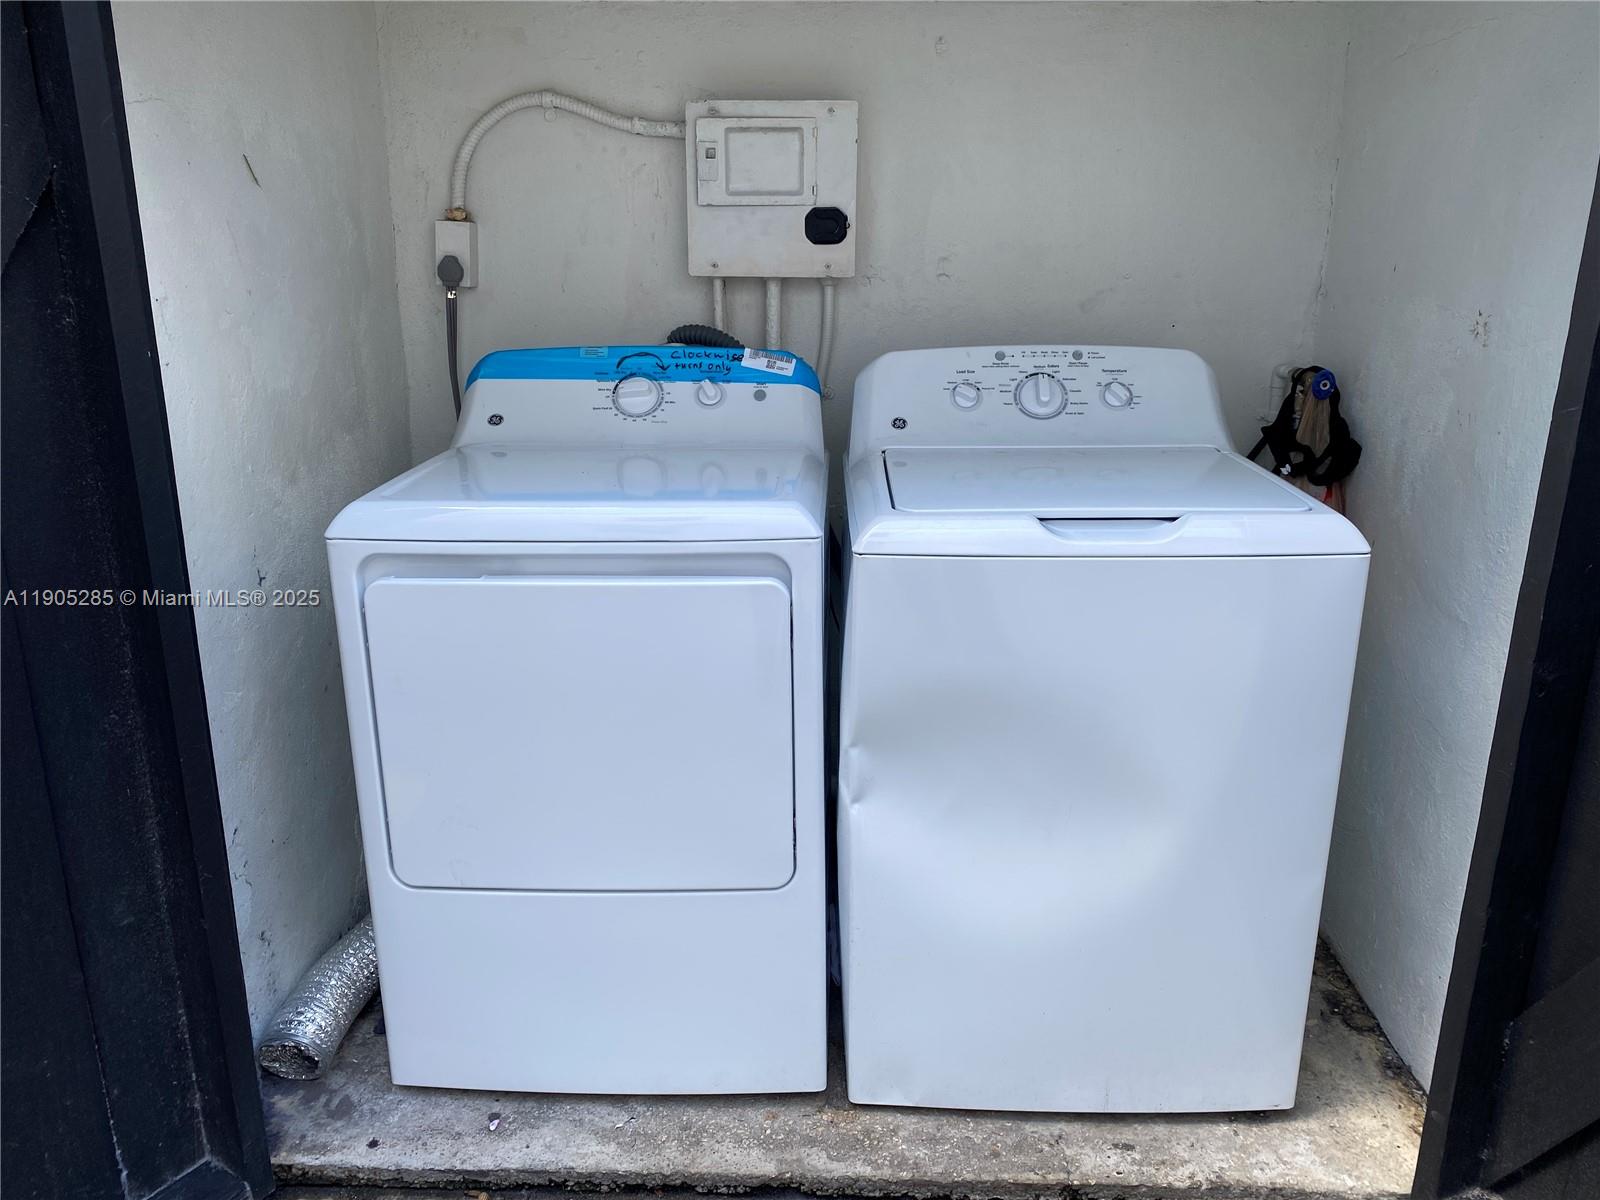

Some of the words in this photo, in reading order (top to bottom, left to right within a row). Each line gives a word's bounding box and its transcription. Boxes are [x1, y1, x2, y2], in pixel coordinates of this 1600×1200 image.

[670, 350, 744, 362] Clockwise
[675, 361, 703, 370] turns
[707, 361, 732, 375] only
